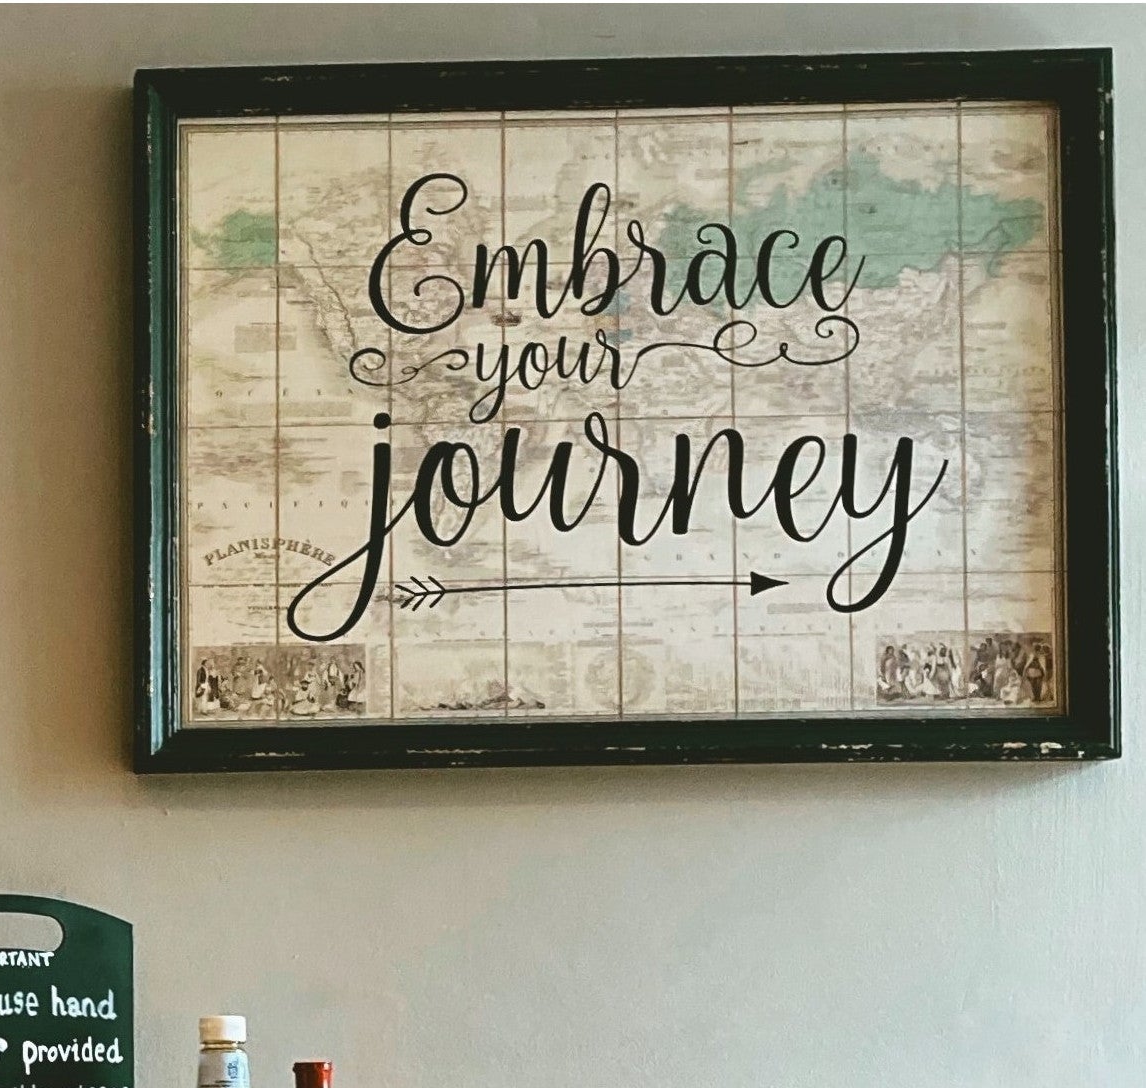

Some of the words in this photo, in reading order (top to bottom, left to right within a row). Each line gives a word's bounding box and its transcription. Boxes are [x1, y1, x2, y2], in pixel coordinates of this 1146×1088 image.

[368, 173, 865, 334] Embrace
[469, 328, 642, 425] your
[287, 411, 948, 642] journey
[51, 984, 118, 1021] hand
[22, 1035, 124, 1076] provided
